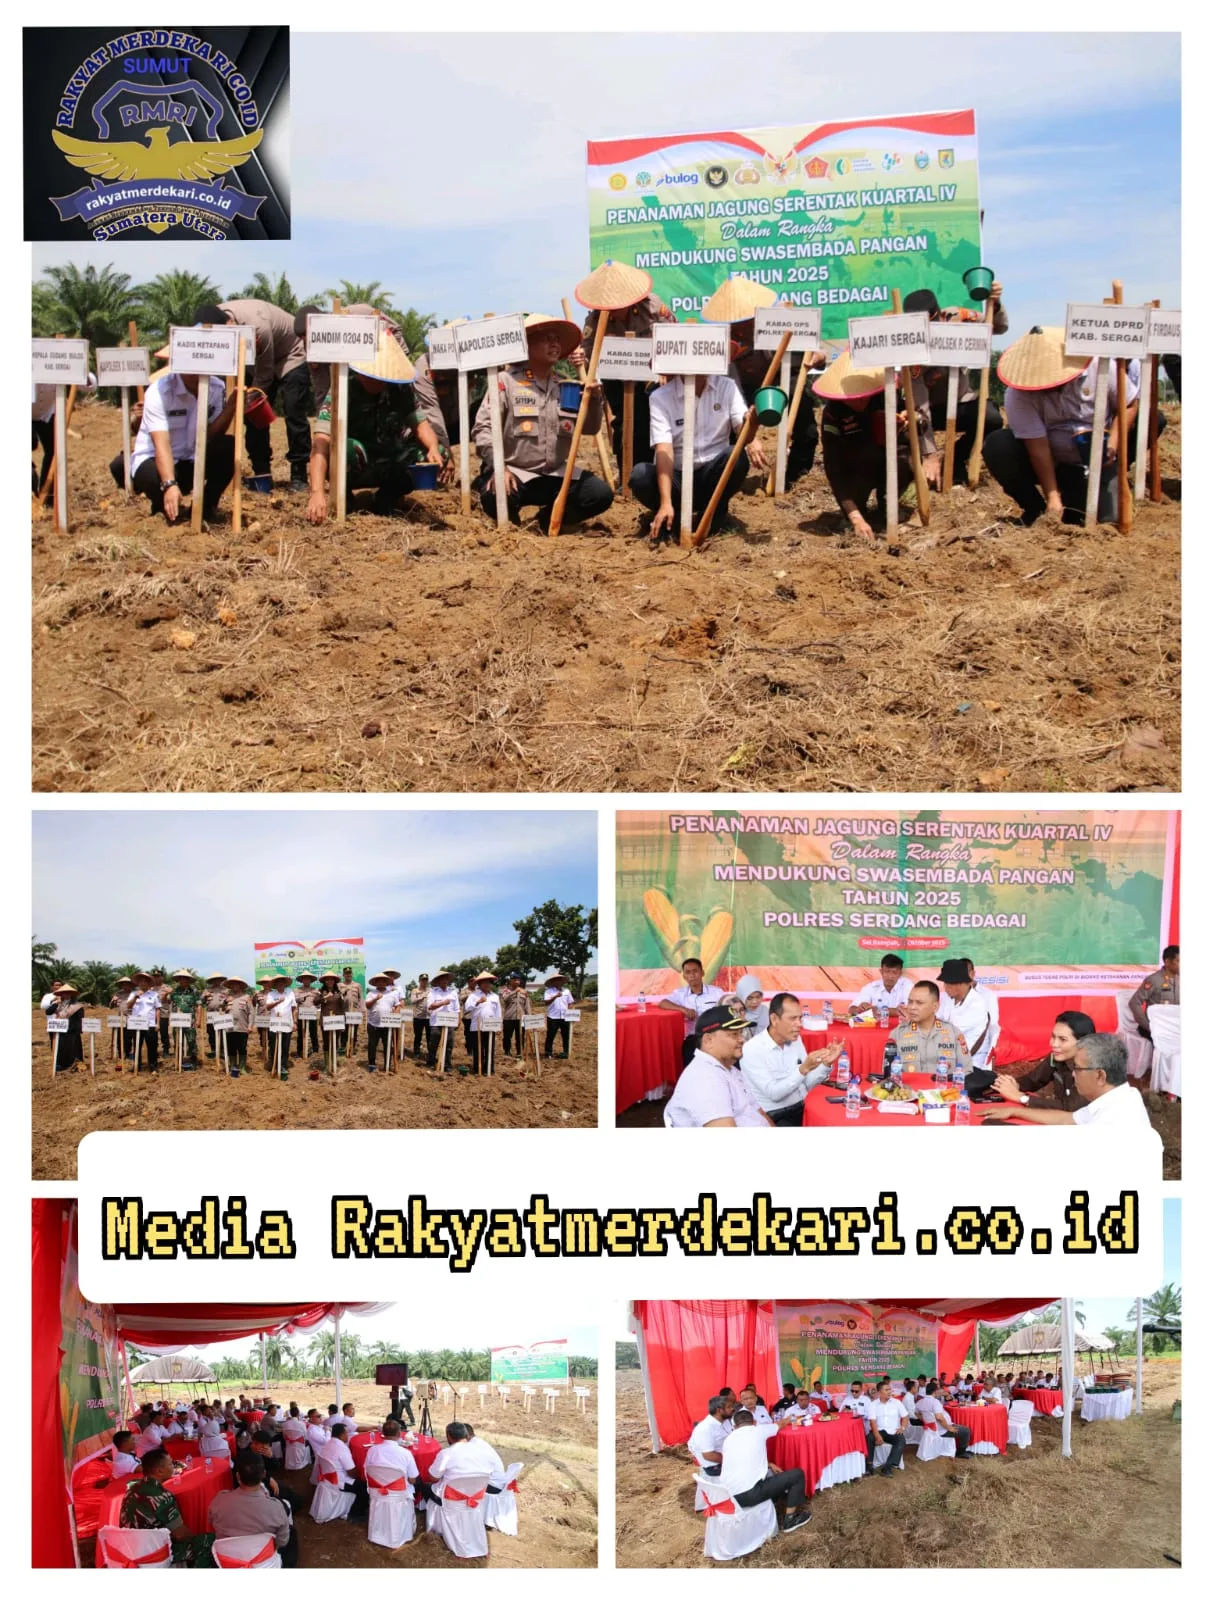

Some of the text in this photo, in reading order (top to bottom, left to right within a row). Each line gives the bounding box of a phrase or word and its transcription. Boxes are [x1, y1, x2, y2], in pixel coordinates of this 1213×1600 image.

[665, 173, 698, 185] bulog
[607, 184, 956, 225] PENANAMAN JAGUNG SERENTAK KUARTAL IV
[721, 216, 834, 241] Dalam Rangka
[636, 235, 927, 268] MENDUKUNG SWASEMBADA PANGAN
[787, 265, 829, 283] 2025
[817, 286, 888, 304] BEDAGAI
[1072, 319, 1144, 329] KETUA DPRD
[197, 341, 230, 349] KETAPANG
[311, 331, 374, 345] DANDIM 0204 DS
[458, 335, 495, 353] KAPOLRES
[496, 329, 522, 345] SERGAI
[853, 331, 925, 349] KAJARI SERGAI
[929, 337, 957, 349] APOLSEK
[1071, 332, 1143, 342] KAB. SERGAI
[656, 341, 725, 356] BUPATI SERGAI
[670, 815, 1113, 842] PENANAMAN JAGUNG SERENTAK KUARTAL IV
[830, 840, 972, 867] Dalam Rangka
[713, 865, 1076, 885] MENDUKUNG SWASEMBADA PANGAN
[842, 889, 961, 906] TAHUN 2025
[763, 911, 1027, 929] POLRES SERDANG BEDAGAI
